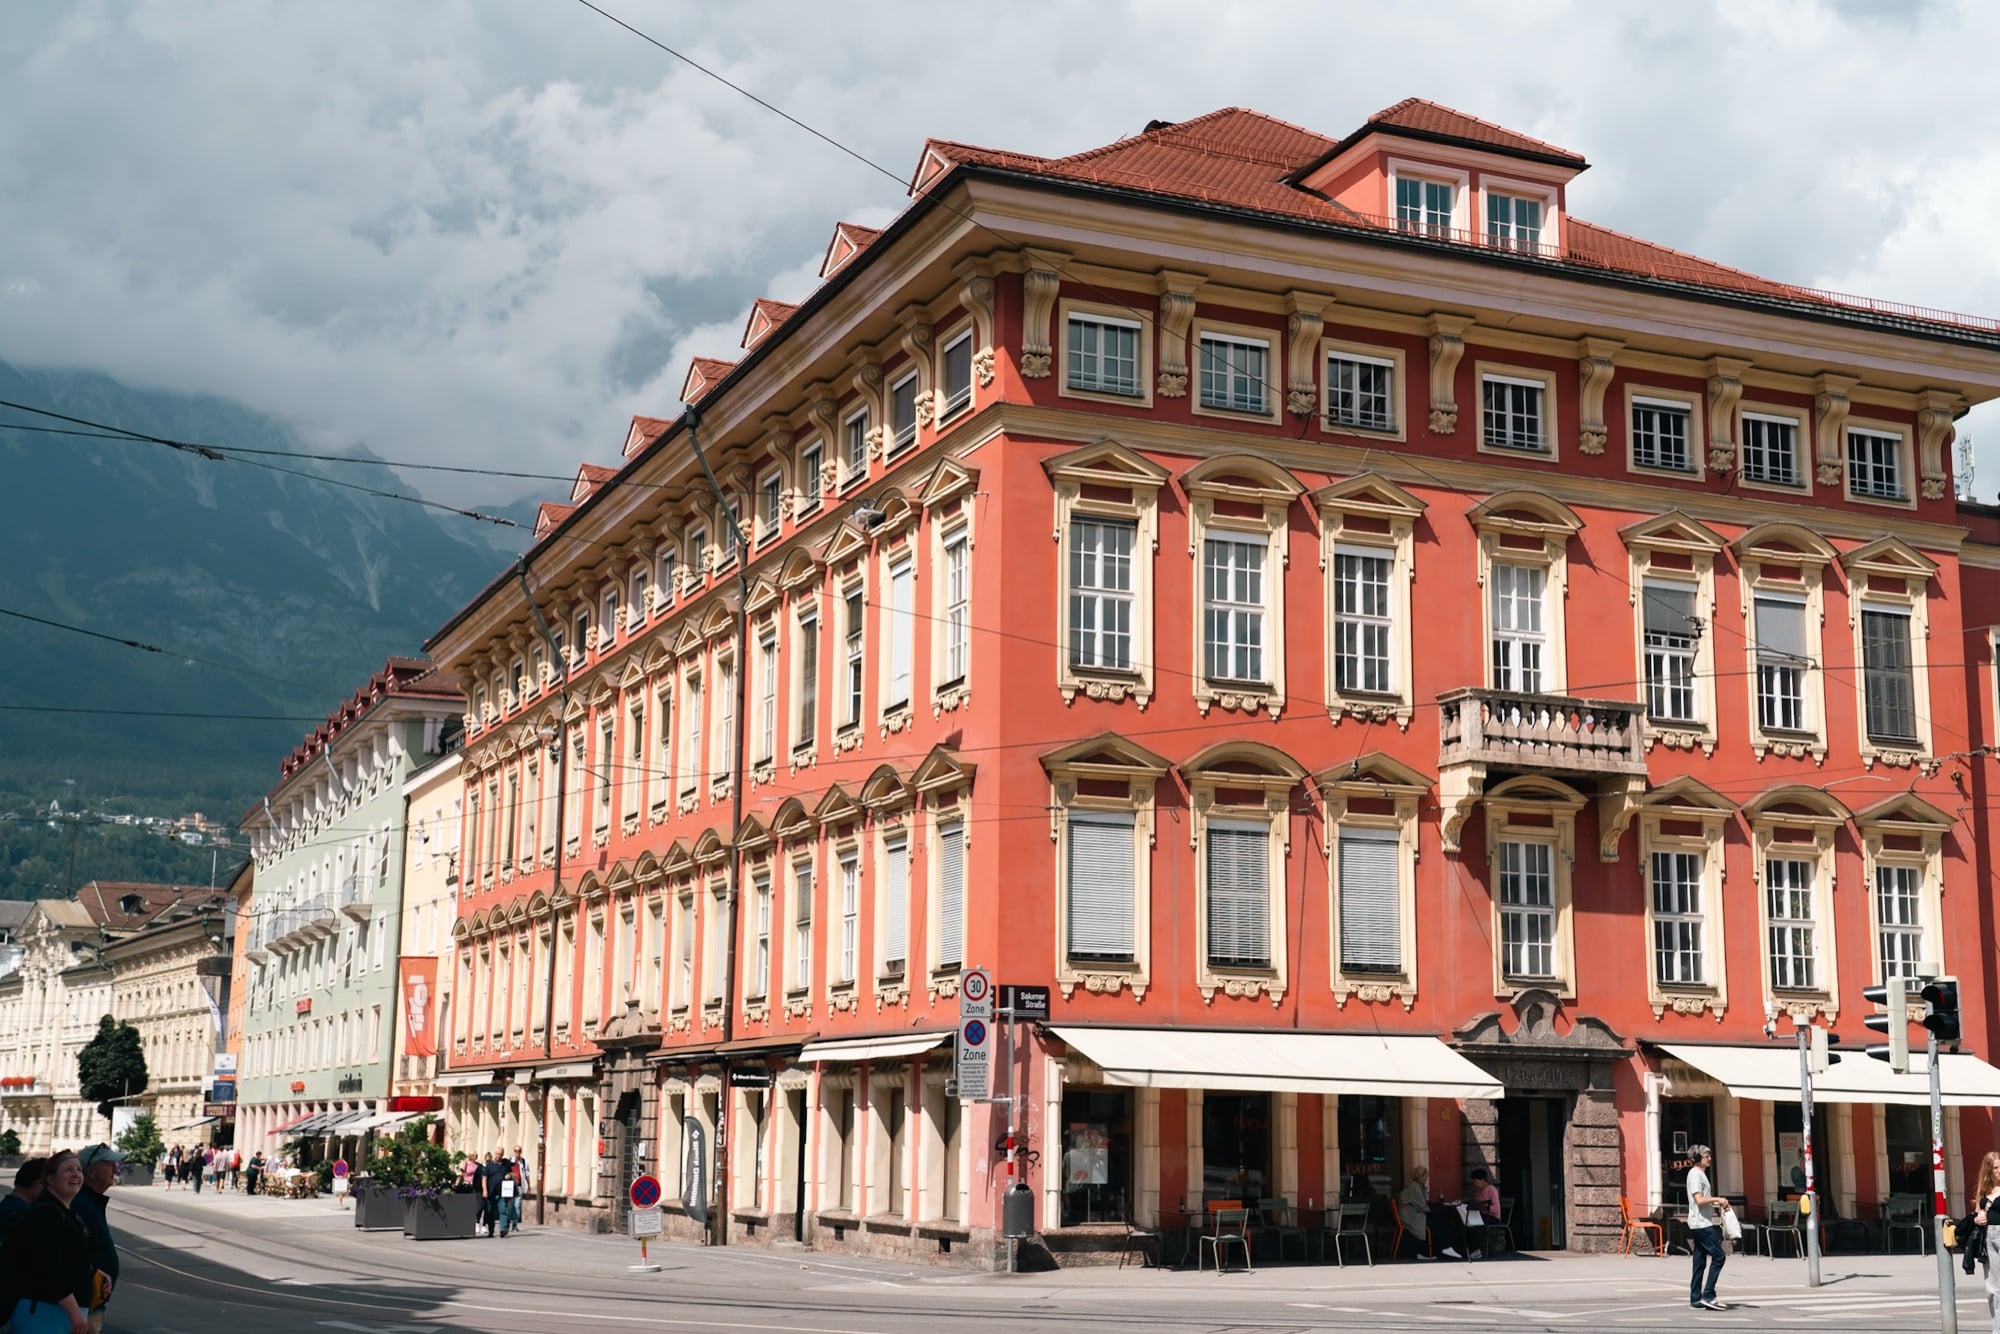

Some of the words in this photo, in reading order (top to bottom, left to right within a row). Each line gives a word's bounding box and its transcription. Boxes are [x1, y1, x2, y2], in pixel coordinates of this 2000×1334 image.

[970, 980, 982, 993] 30
[966, 1004, 985, 1013] Zone
[963, 1049, 986, 1061] Zone
